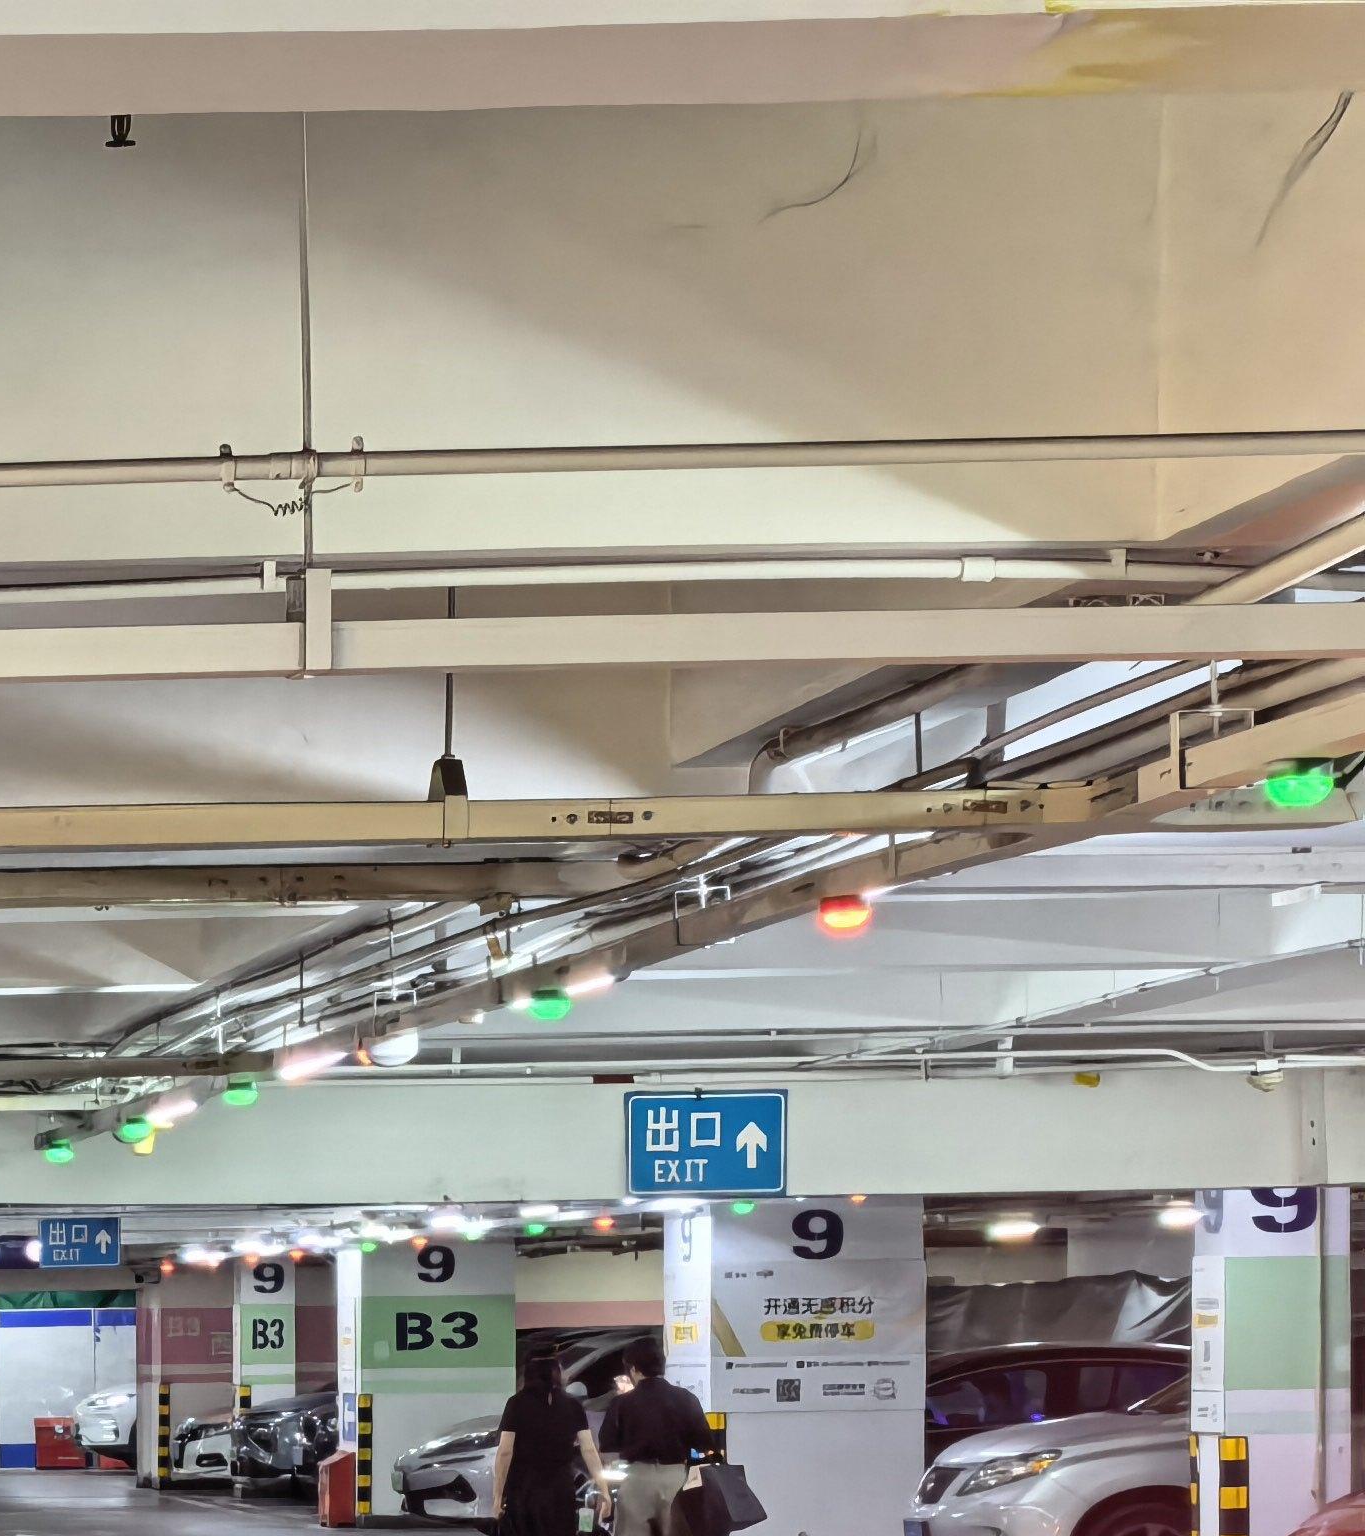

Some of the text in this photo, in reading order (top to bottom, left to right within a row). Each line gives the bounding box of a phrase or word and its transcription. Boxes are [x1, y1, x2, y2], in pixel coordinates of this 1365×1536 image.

[646, 1107, 721, 1153] 出口
[654, 1159, 709, 1183] EXIT
[49, 1222, 88, 1246] 出口
[792, 1209, 844, 1260] 9
[253, 1263, 285, 1294] 9
[417, 1246, 456, 1283] 9
[251, 1318, 285, 1350] B3
[395, 1311, 479, 1352] B3
